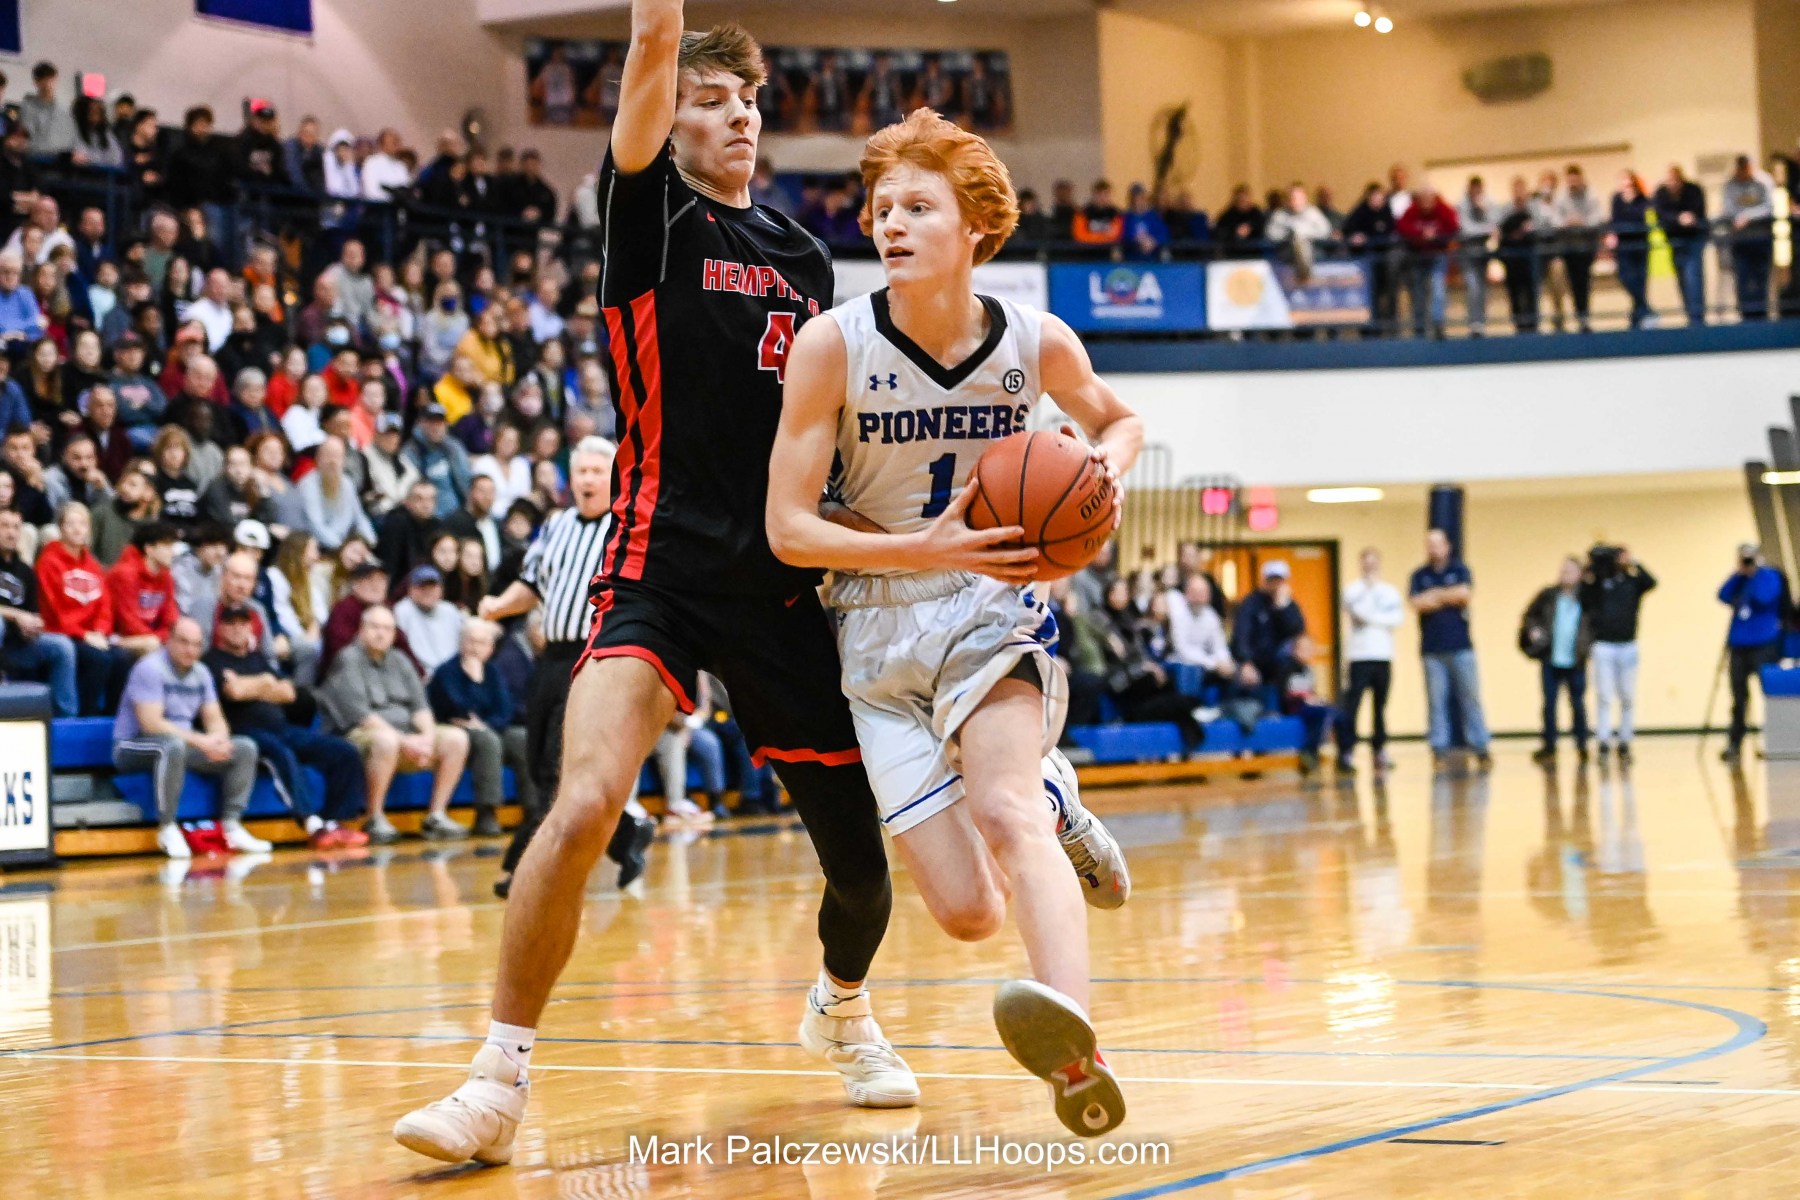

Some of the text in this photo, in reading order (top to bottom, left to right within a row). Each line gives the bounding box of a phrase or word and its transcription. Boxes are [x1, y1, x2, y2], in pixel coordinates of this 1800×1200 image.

[702, 258, 820, 317] HEMPF
[757, 311, 797, 384] 4
[857, 404, 1029, 444] PIONEERS
[920, 452, 957, 519] 1
